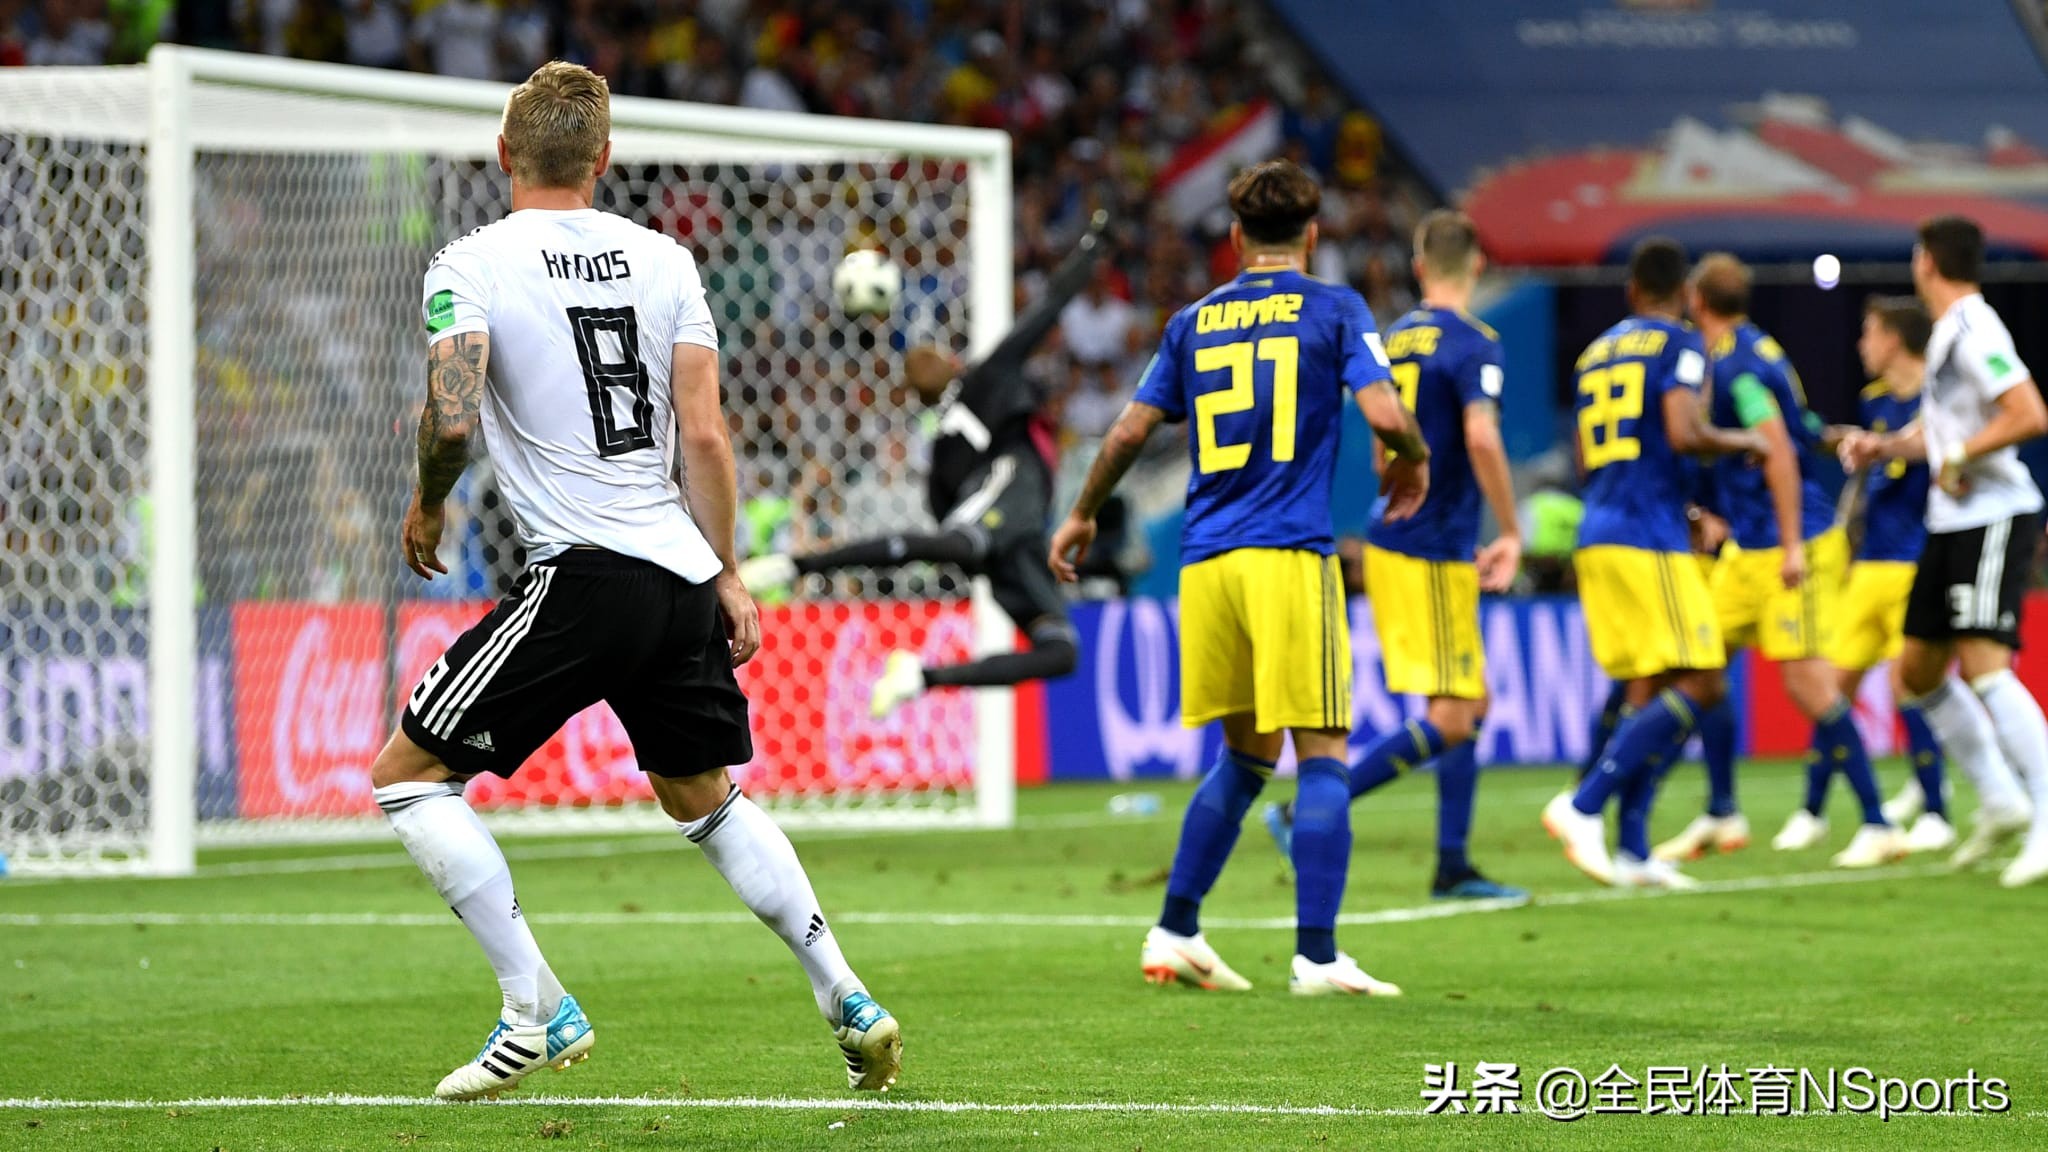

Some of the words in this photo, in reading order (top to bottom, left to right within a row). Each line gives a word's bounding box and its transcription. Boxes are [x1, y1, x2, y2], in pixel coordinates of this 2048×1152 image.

[566, 306, 656, 458] 8
[1947, 583, 1974, 630] 3
[462, 737, 496, 752] adidas
